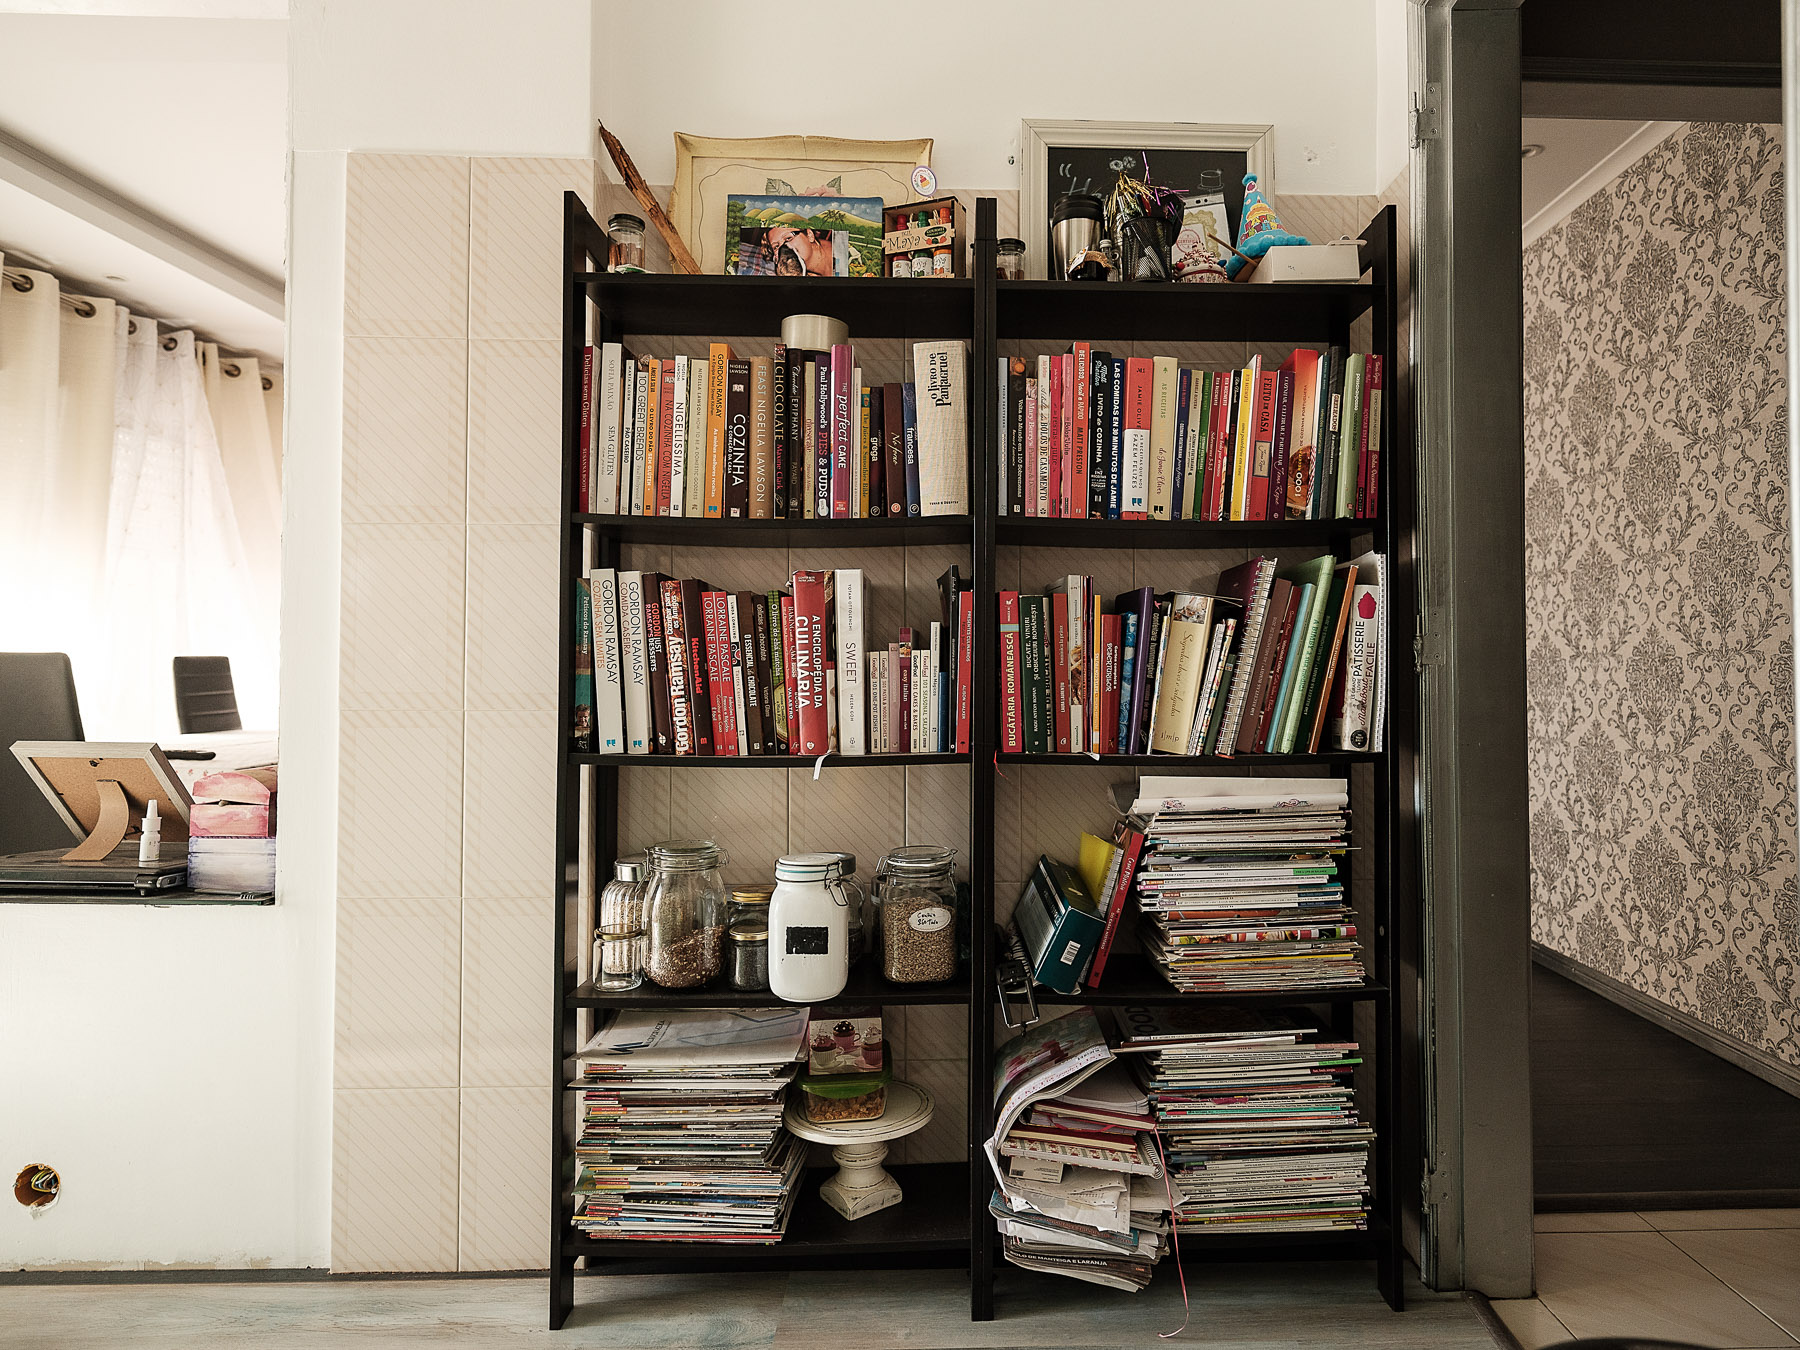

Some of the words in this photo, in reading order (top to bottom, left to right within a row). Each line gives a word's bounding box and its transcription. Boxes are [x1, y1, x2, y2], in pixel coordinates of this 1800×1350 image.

[886, 236, 921, 252] Maya
[758, 366, 766, 395] FEAST
[1263, 378, 1272, 401] FEITO
[637, 395, 646, 425] GREAT
[665, 400, 672, 411] NA
[775, 366, 784, 440] CHOCOLATE
[836, 395, 850, 442] perfect
[649, 431, 653, 439] DO
[663, 414, 672, 448] COZINHA
[673, 402, 684, 476] NIGELLISSIMA
[757, 400, 765, 447] NIGELLA
[1040, 422, 1048, 444] BOLOS
[1112, 428, 1118, 436] 30
[1113, 416, 1119, 427] EN
[1260, 411, 1270, 433] CASA
[607, 443, 615, 476] GLÚTEN
[636, 427, 645, 461] BREADS
[663, 450, 672, 468] COM
[732, 414, 745, 486] COZINHA
[819, 432, 827, 455] PIES
[870, 437, 878, 461] grega
[1018, 443, 1021, 451] em
[1040, 447, 1047, 456] DE
[662, 470, 671, 500] NIGELLA
[756, 452, 765, 502] LAWSON
[1111, 473, 1117, 484] DE
[593, 580, 602, 619] COZINHA
[602, 580, 615, 633] GORDON
[620, 582, 629, 617] COMIDA
[629, 582, 641, 636] GORDON
[594, 622, 603, 638] SEM
[652, 602, 661, 637] GORDON
[704, 597, 716, 642] LORRAINE
[717, 597, 728, 642] LORRAINE
[773, 629, 779, 637] do
[1150, 613, 1160, 641] confeitaria
[596, 640, 604, 668] LIMITES
[622, 620, 630, 656] CASEIRA
[648, 638, 657, 672] DESSERTS
[1180, 631, 1193, 663] Segredos
[1350, 621, 1365, 677] PÂTISSERIE
[606, 638, 617, 684] RAMSAY
[632, 639, 643, 686] RAMSAY
[668, 636, 684, 696] Ramsay
[691, 638, 702, 694] KitchenAid
[706, 644, 718, 682] PASCALE
[720, 644, 730, 682] PASCALE
[797, 616, 812, 708] CULINÁRIA
[813, 624, 824, 693] ENCICLOPÉDIA
[846, 642, 857, 684] SWEET
[1005, 633, 1015, 693] ROMÂNEASCĂ
[1146, 642, 1157, 678] hummingbird
[1366, 642, 1375, 678] FACILE
[814, 695, 822, 708] DA
[1170, 688, 1183, 717] salgados
[1357, 678, 1368, 725] Marabout
[673, 698, 689, 751] Gordon
[1007, 696, 1016, 746] BUCĂTĂRIA
